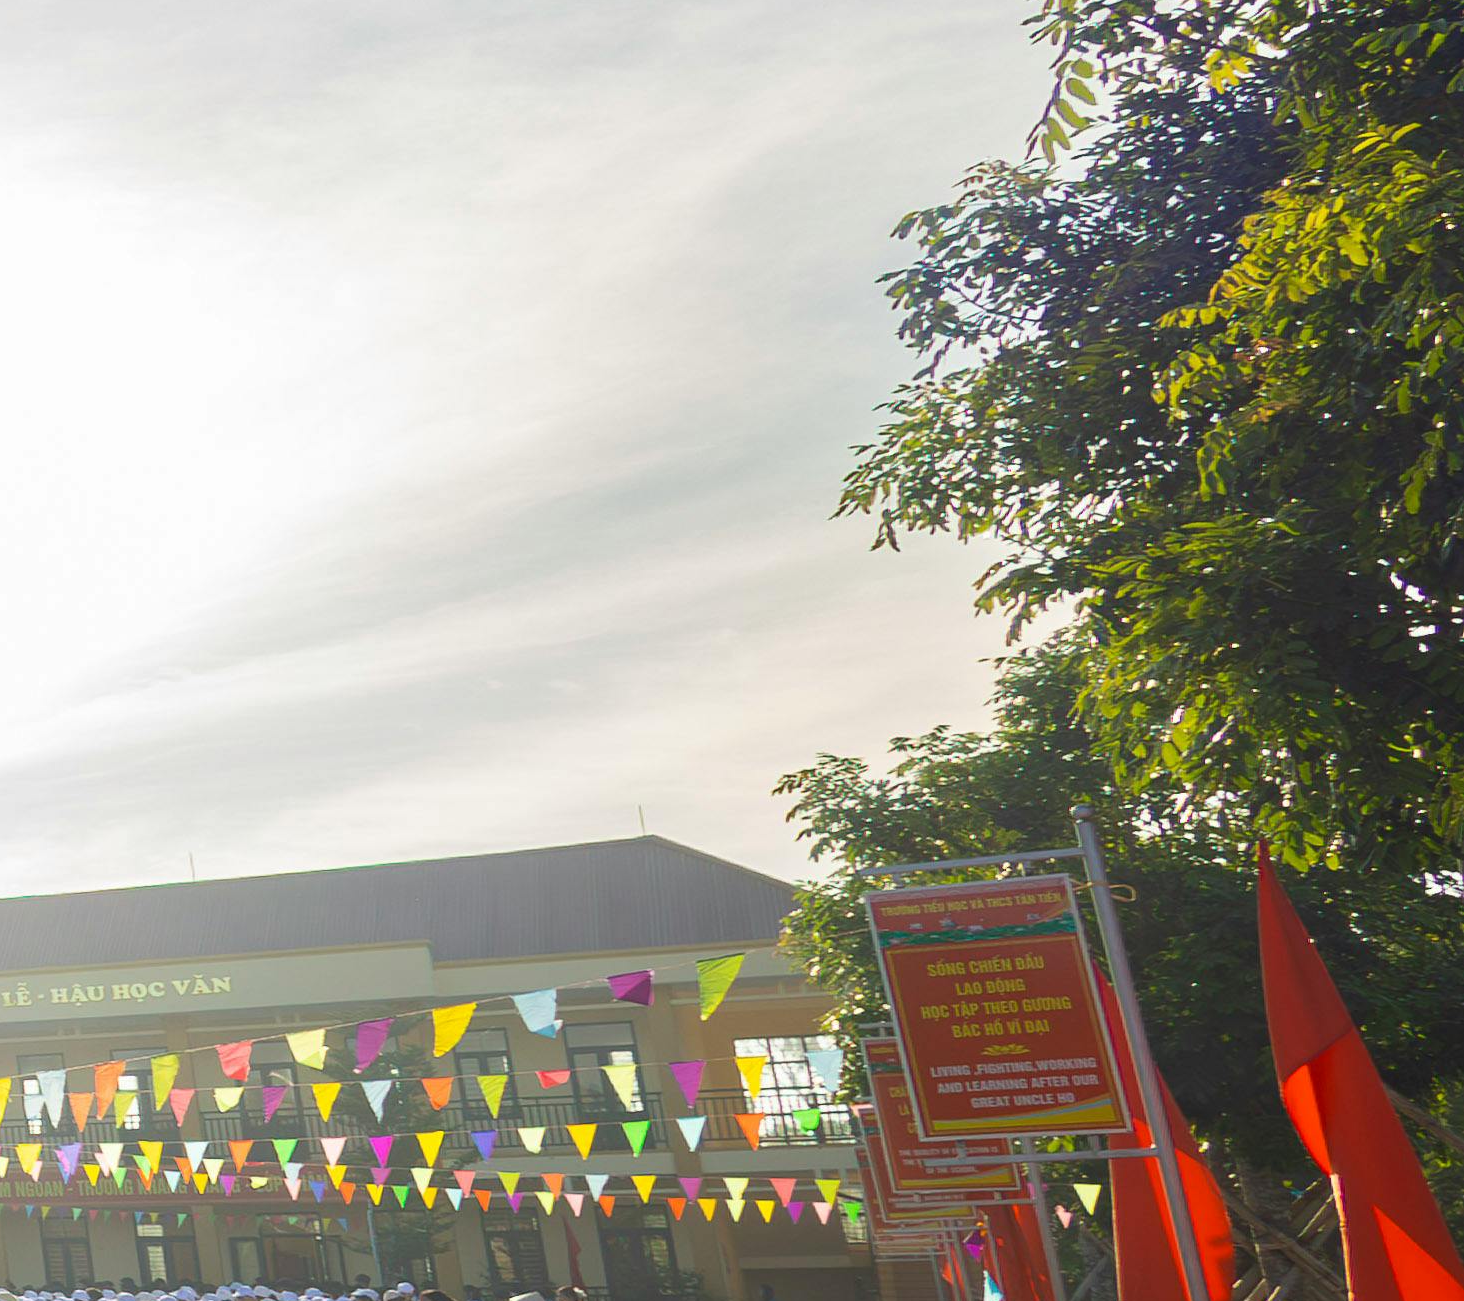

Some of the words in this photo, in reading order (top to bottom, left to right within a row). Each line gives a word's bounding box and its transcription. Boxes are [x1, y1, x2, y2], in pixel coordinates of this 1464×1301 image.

[927, 959, 966, 977] SỐNG
[969, 953, 1013, 974] CHIẾN
[1, 982, 32, 1007] LỄ
[50, 983, 105, 1007] HẬU
[112, 981, 165, 1003] HỌC
[171, 974, 232, 996] VĂN
[956, 982, 983, 996] LAO
[986, 977, 1026, 996] ĐỘNG
[921, 1004, 950, 1022] HỌC
[952, 1000, 979, 1020] TẬP
[983, 1000, 1018, 1015] THEO
[951, 1022, 981, 1038] BÁC
[930, 1065, 971, 1078] LIVING
[937, 1082, 963, 1094] AND
[966, 1078, 1029, 1092] LEARNING
[1031, 1075, 1069, 1089] AFTER
[1071, 1074, 1099, 1086] OUR
[971, 1095, 1010, 1109] GREAT
[1013, 1093, 1055, 1107] UNCLE
[1056, 1092, 1075, 1104] HO
